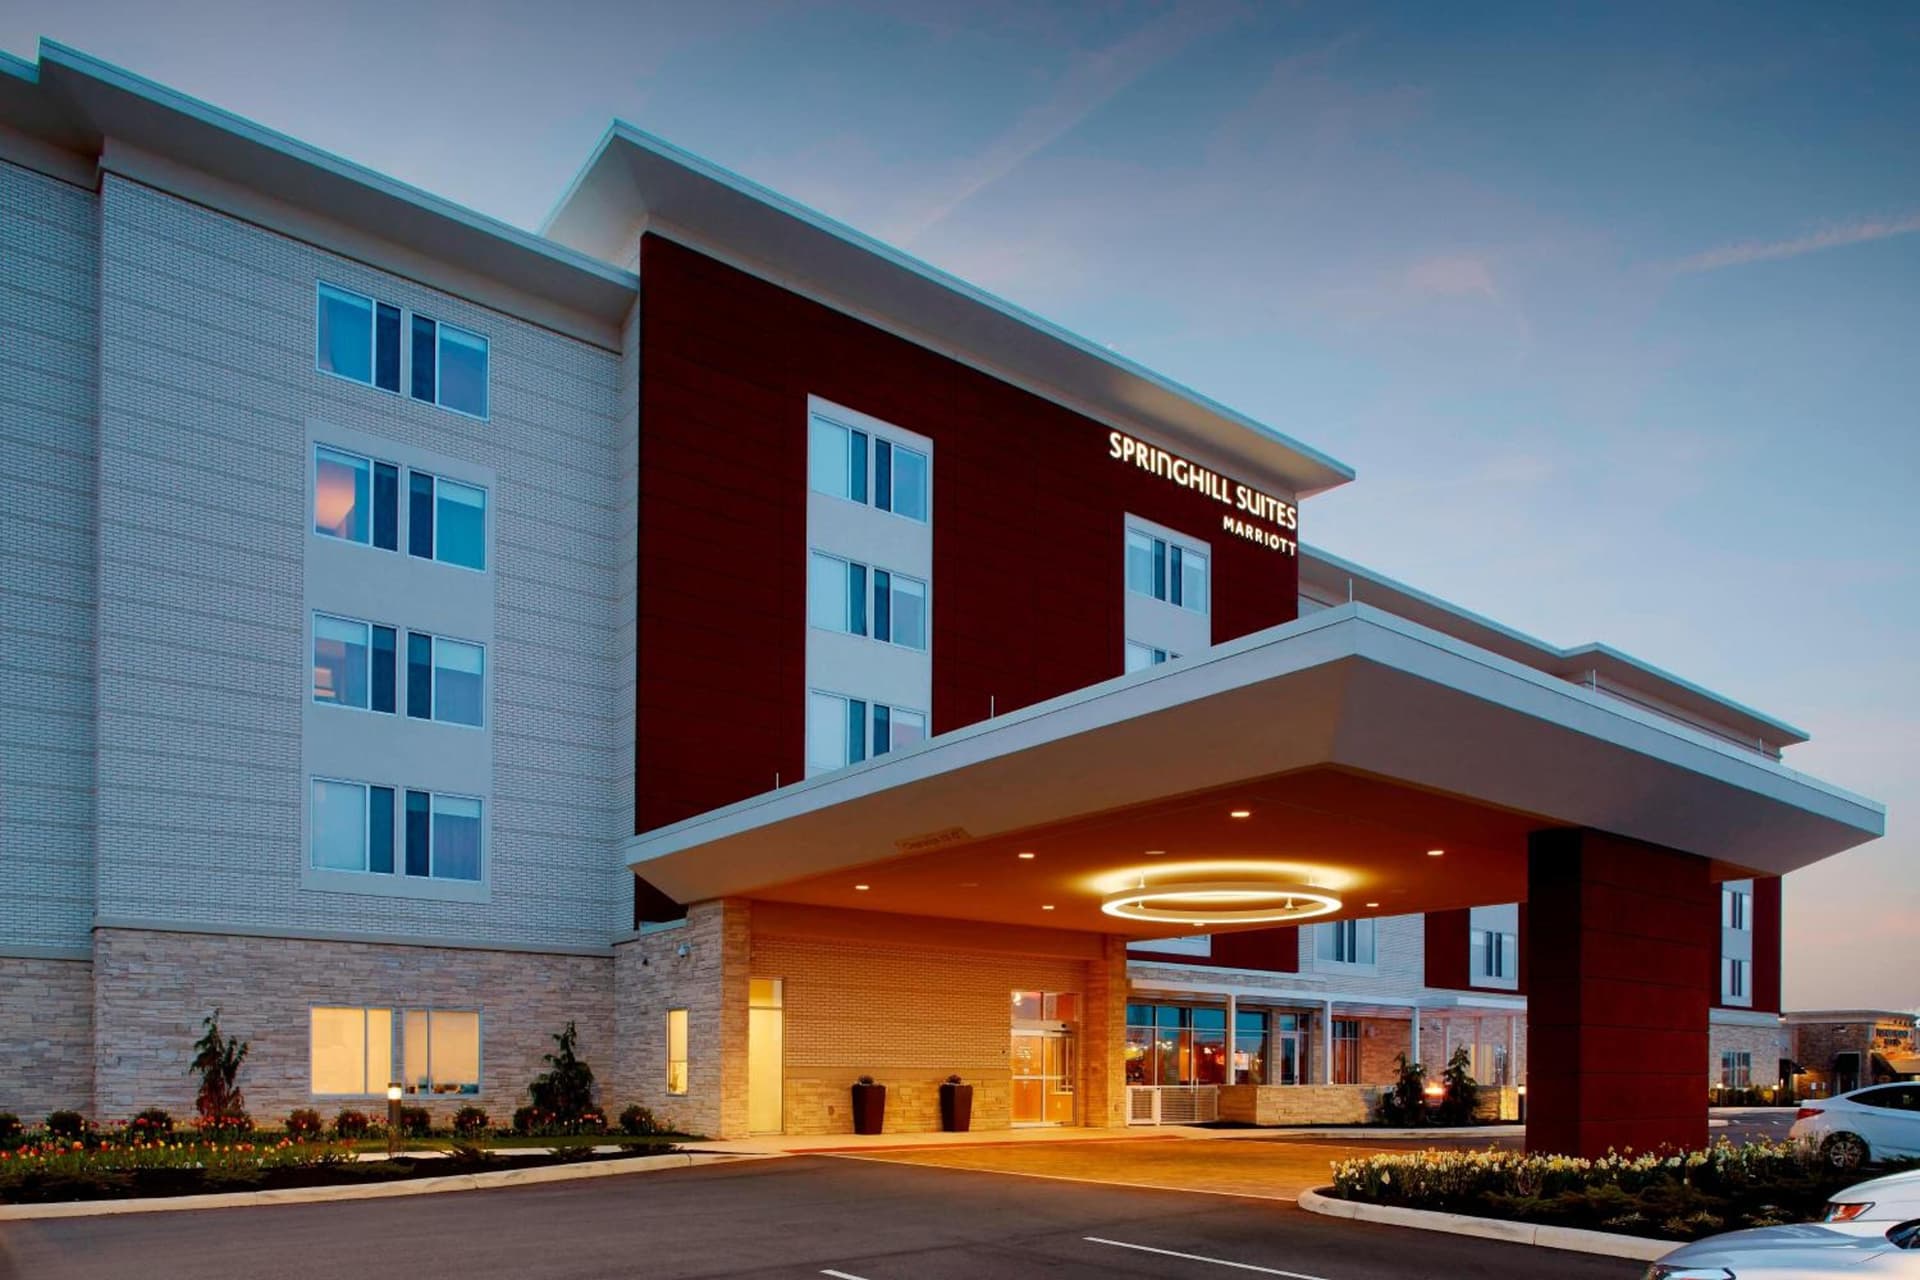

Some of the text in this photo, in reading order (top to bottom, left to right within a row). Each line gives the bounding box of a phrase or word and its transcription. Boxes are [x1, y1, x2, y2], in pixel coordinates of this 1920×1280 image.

[1109, 431, 1297, 530] SPRINGHILL SUITES
[1223, 515, 1297, 556] MARRIOTT
